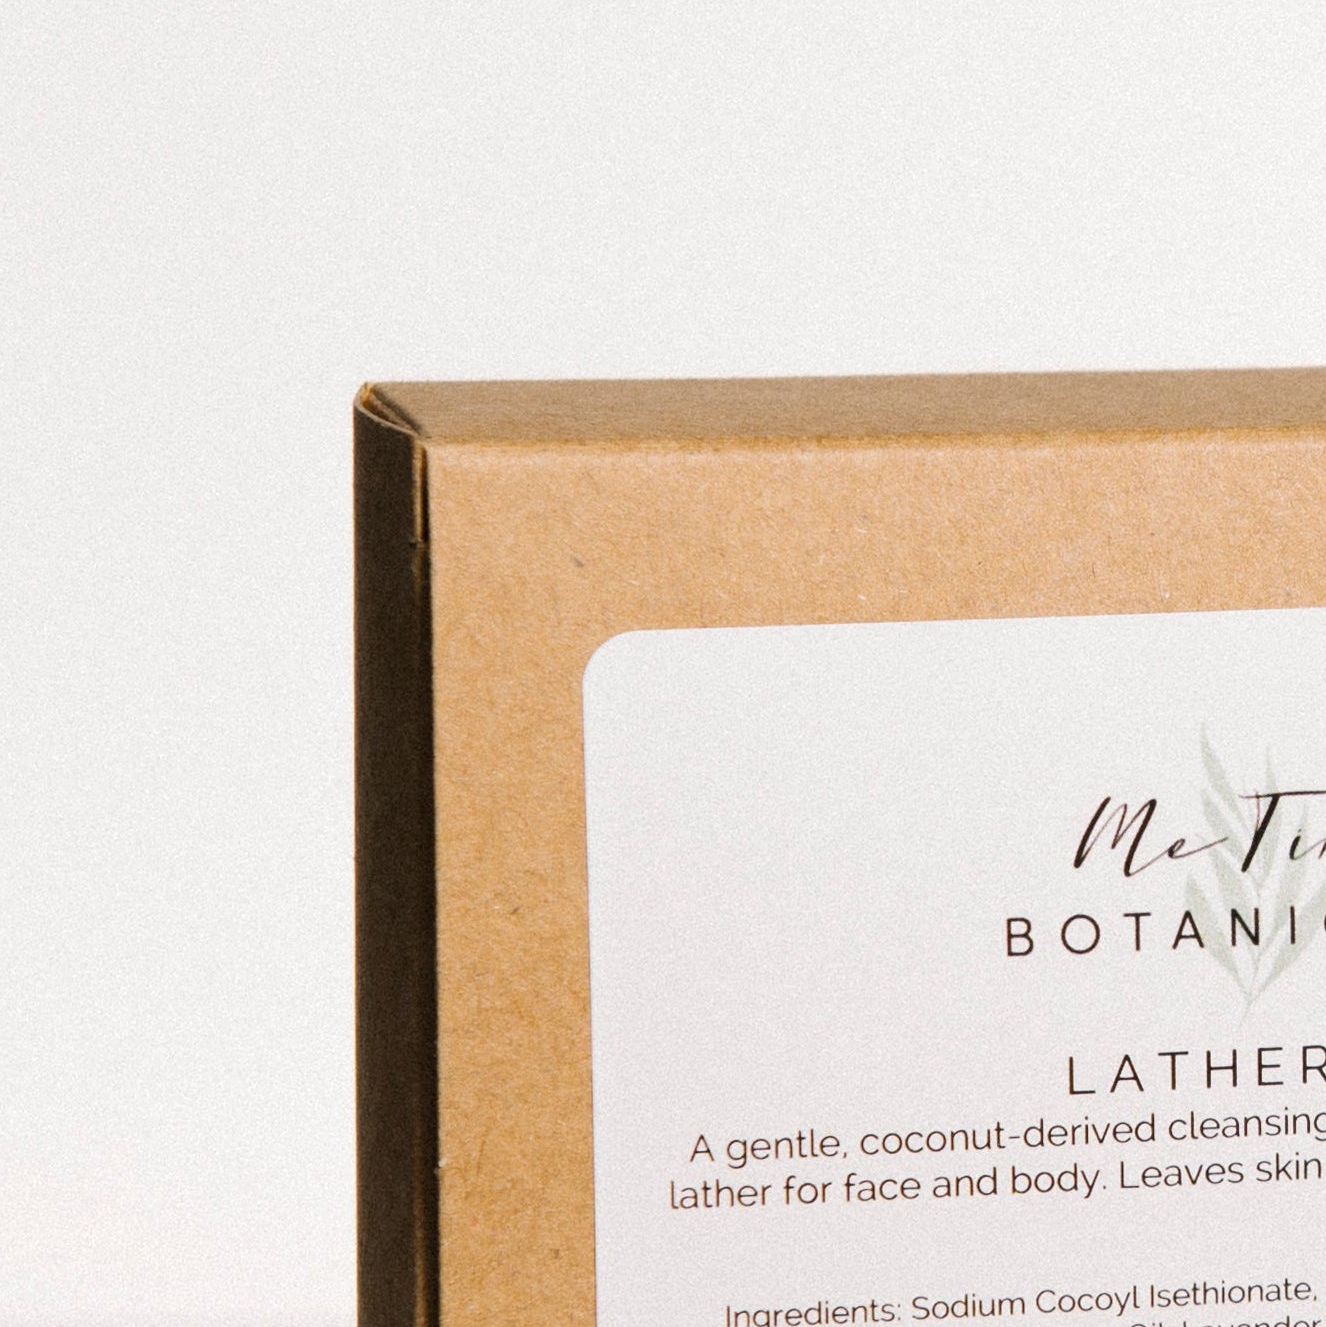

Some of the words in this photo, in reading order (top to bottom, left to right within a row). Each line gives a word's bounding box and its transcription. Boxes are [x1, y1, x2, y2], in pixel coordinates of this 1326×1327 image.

[1072, 796, 1228, 877] Me
[689, 1134, 715, 1162] A
[726, 1128, 847, 1170] gentle,
[860, 1113, 1156, 1156] coconut-derived
[670, 1179, 772, 1210] lather
[783, 1175, 832, 1205] for
[844, 1172, 921, 1202] face
[932, 1166, 998, 1198] and
[1011, 1162, 1108, 1199] body.
[1120, 1161, 1245, 1189] Leaves
[1256, 1151, 1322, 1183] skin
[911, 1293, 1026, 1320] Sodium
[1035, 1285, 1140, 1317] Cocoyl
[1150, 1278, 1317, 1308] Isethionate,
